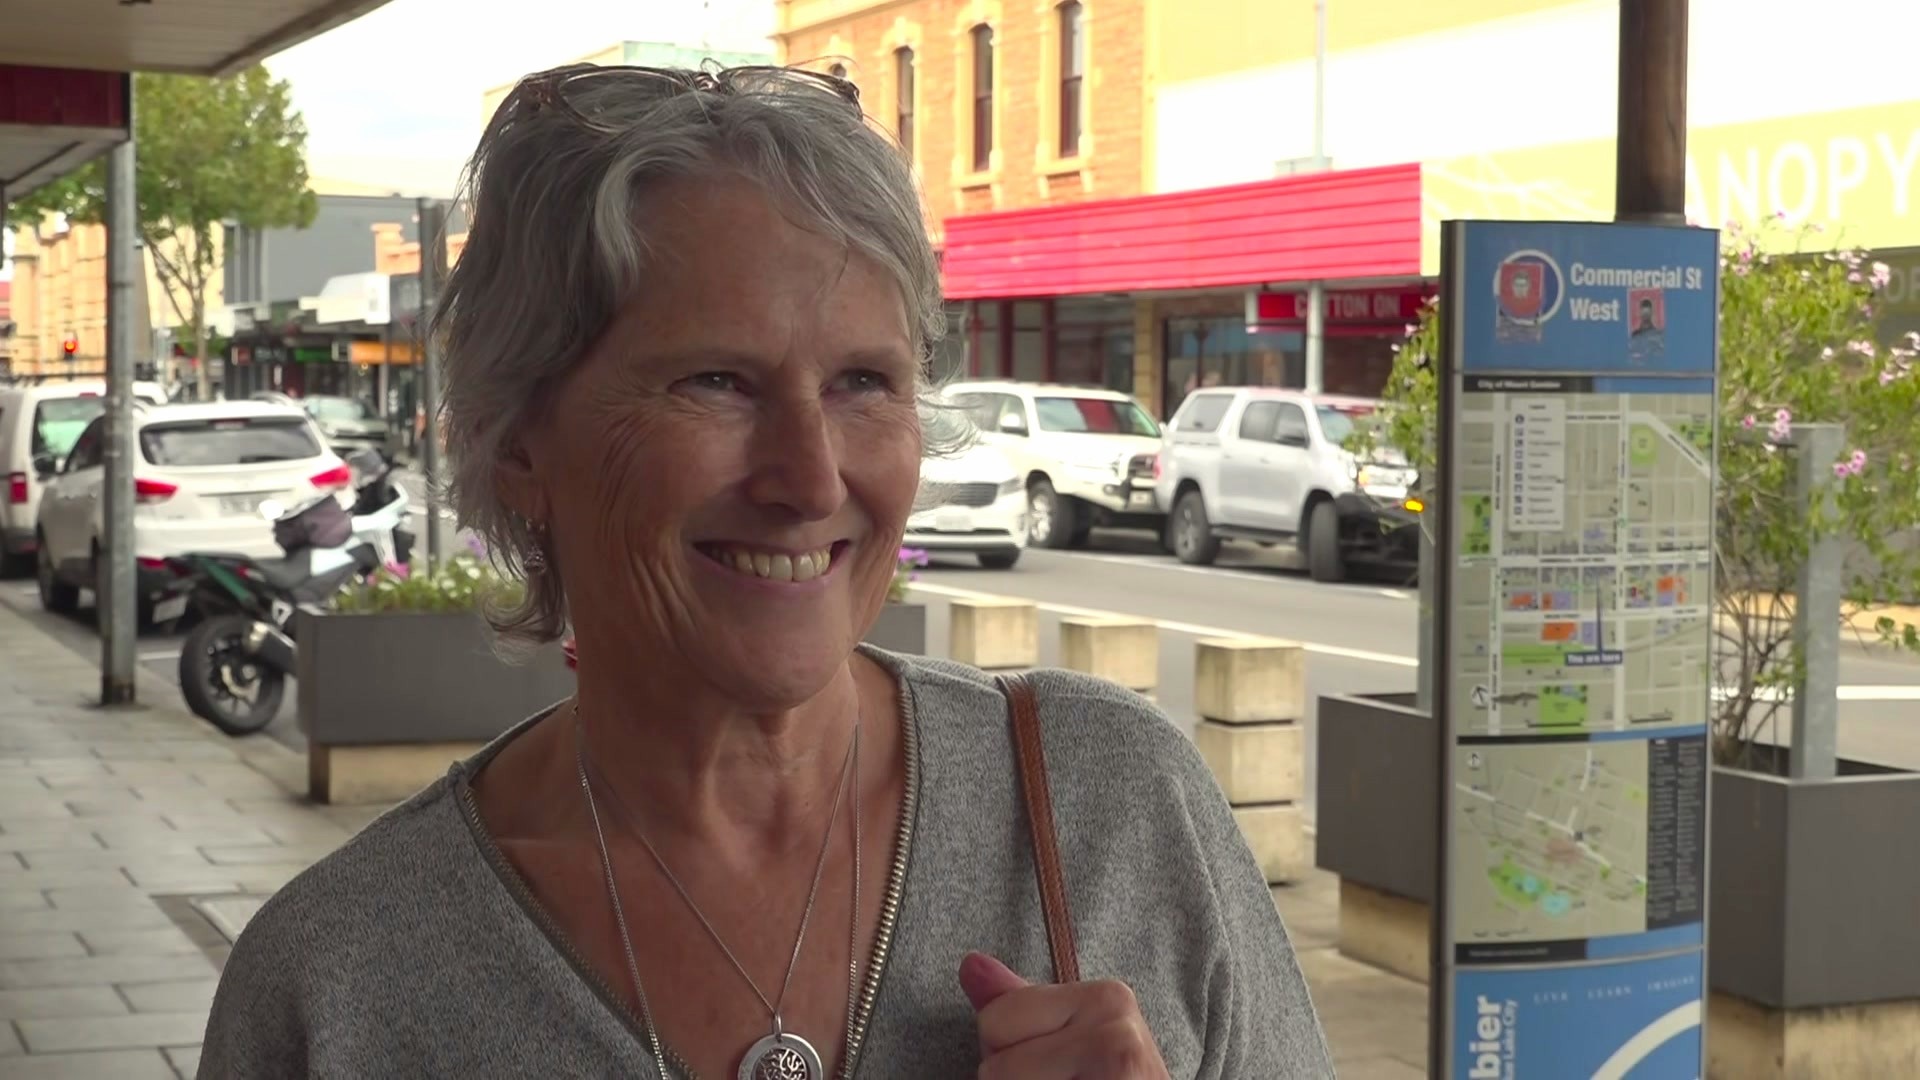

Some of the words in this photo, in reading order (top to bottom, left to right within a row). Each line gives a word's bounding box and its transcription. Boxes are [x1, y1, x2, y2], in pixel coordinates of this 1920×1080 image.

[1570, 263, 1681, 289] Commercial
[1685, 267, 1702, 290] St
[1295, 293, 1369, 319] CTTON
[1374, 293, 1399, 318] ON
[1570, 298, 1619, 322] West
[1477, 378, 1493, 390] City
